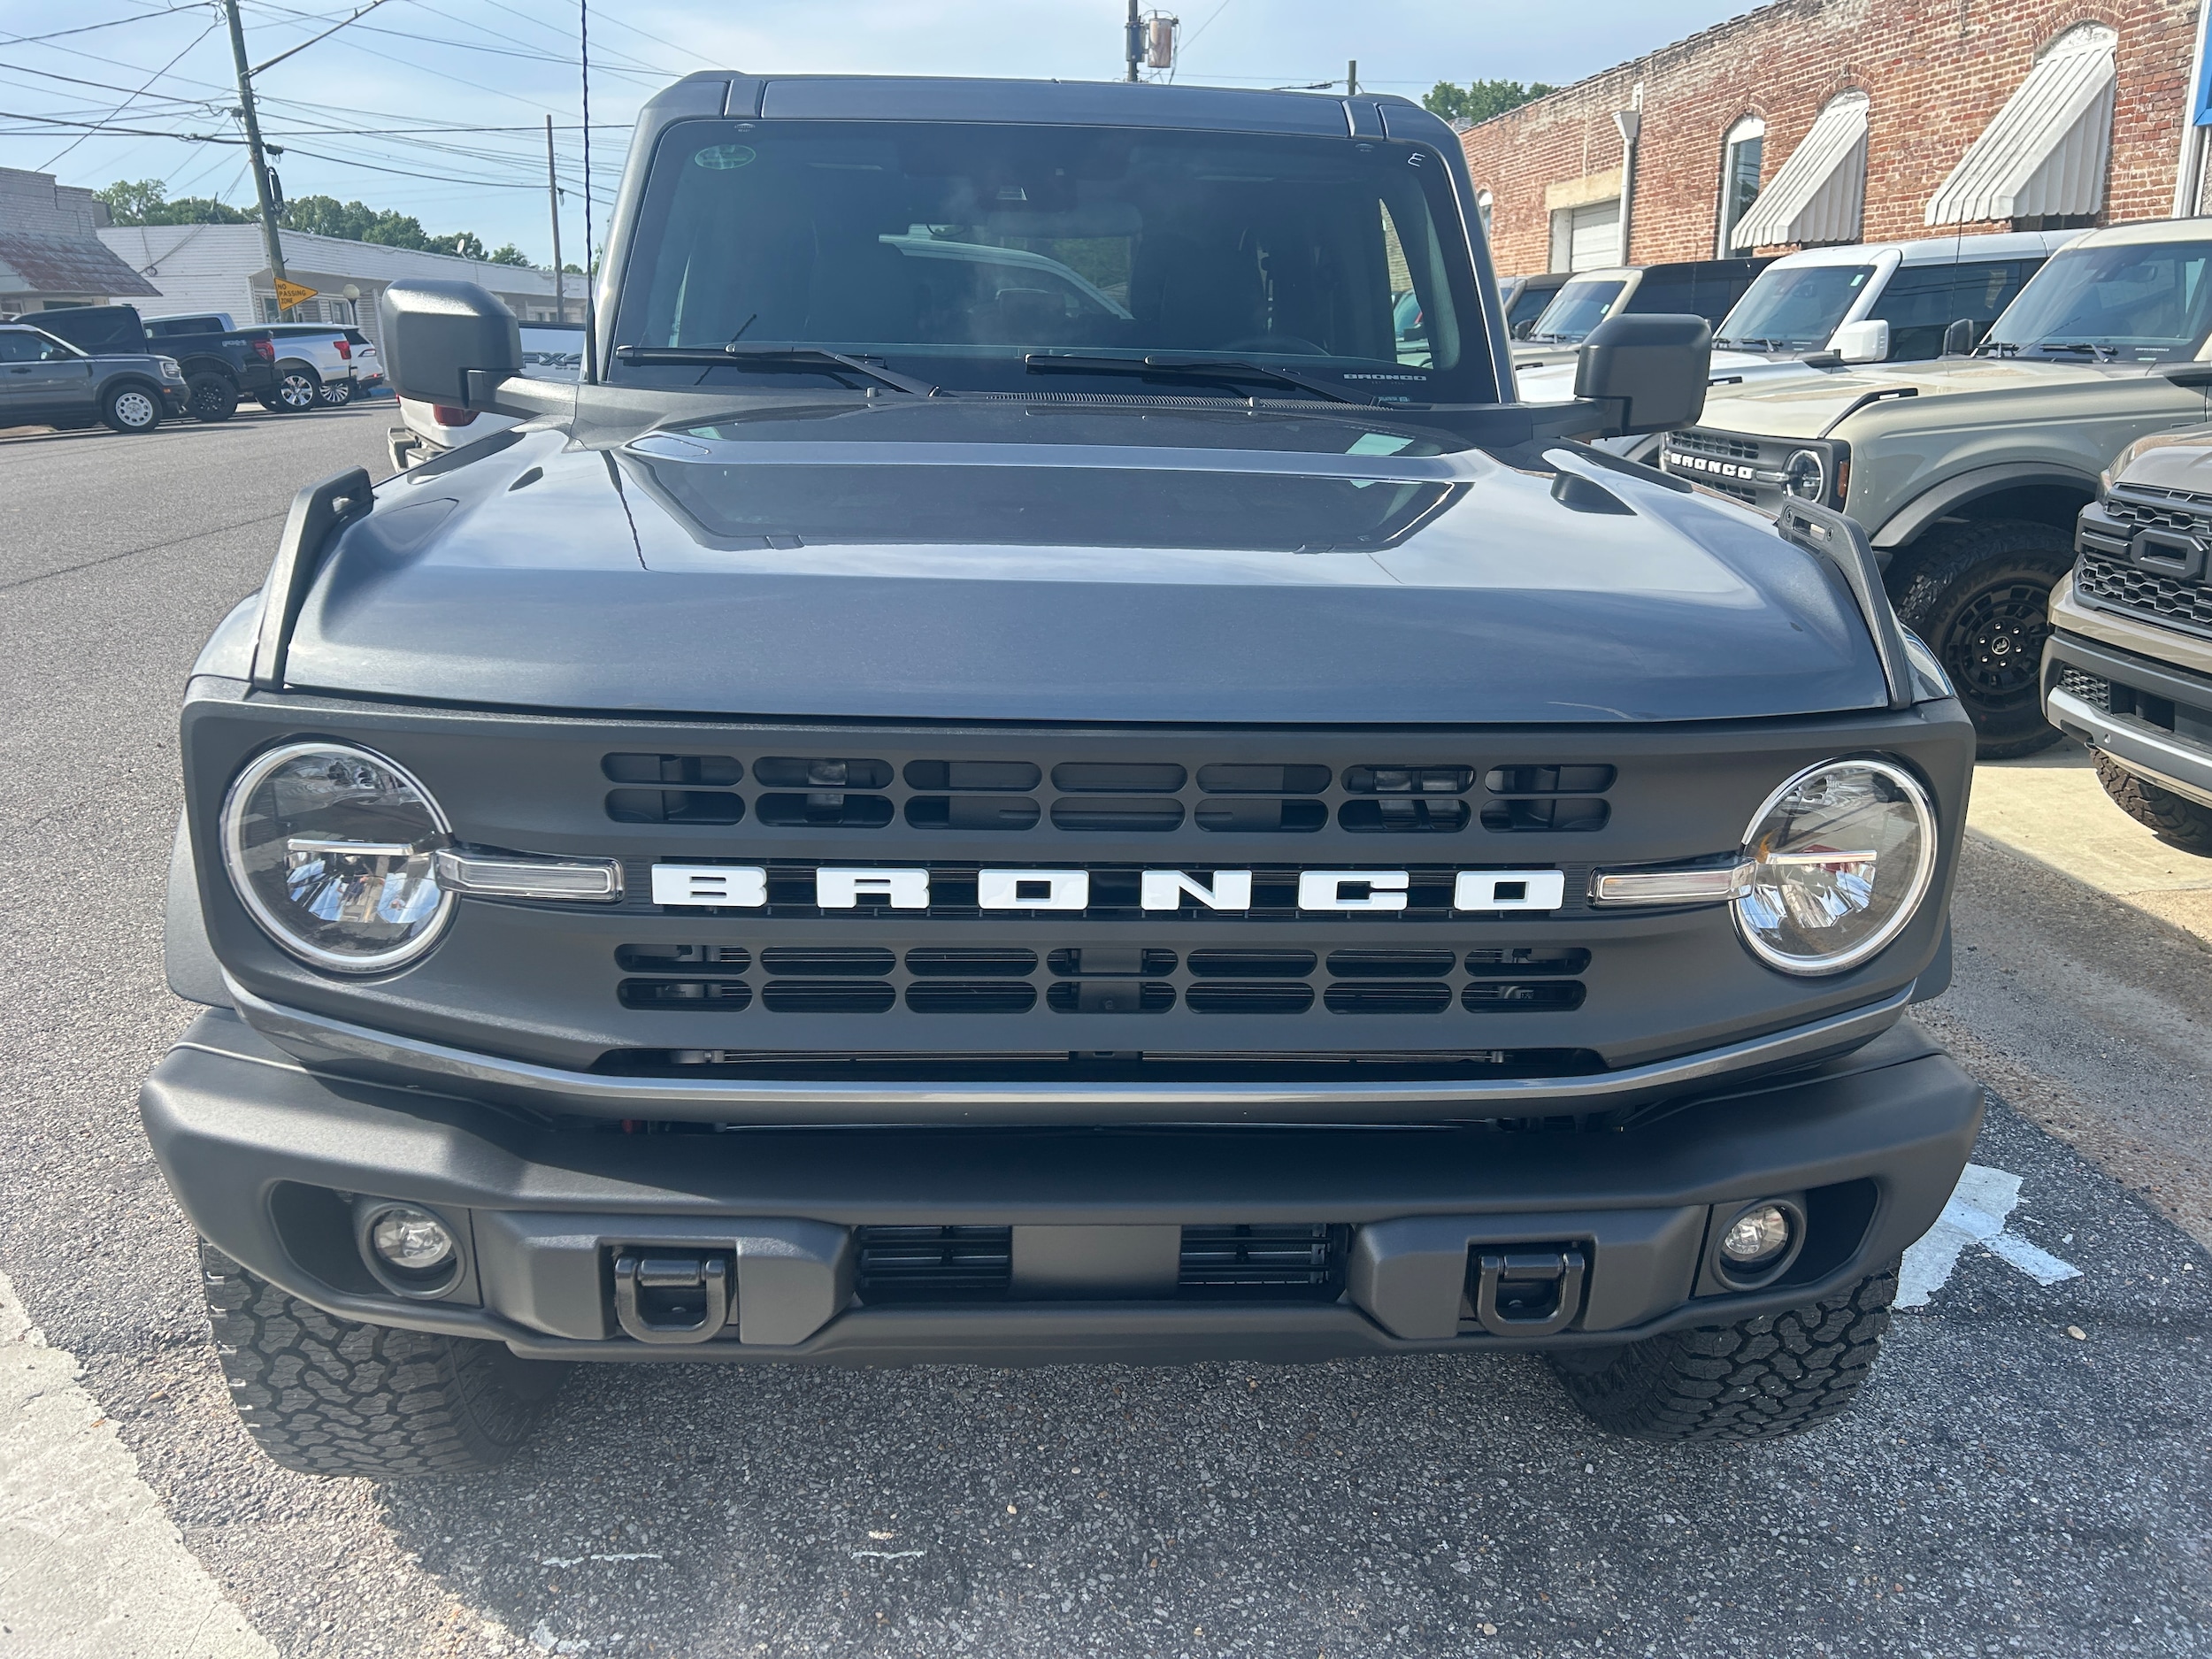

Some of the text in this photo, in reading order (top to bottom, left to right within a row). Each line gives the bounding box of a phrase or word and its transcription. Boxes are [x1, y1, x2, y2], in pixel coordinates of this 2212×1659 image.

[1407, 152, 1426, 168] E
[1671, 452, 1754, 480] BRONCO
[651, 863, 1564, 911] BRONCO
